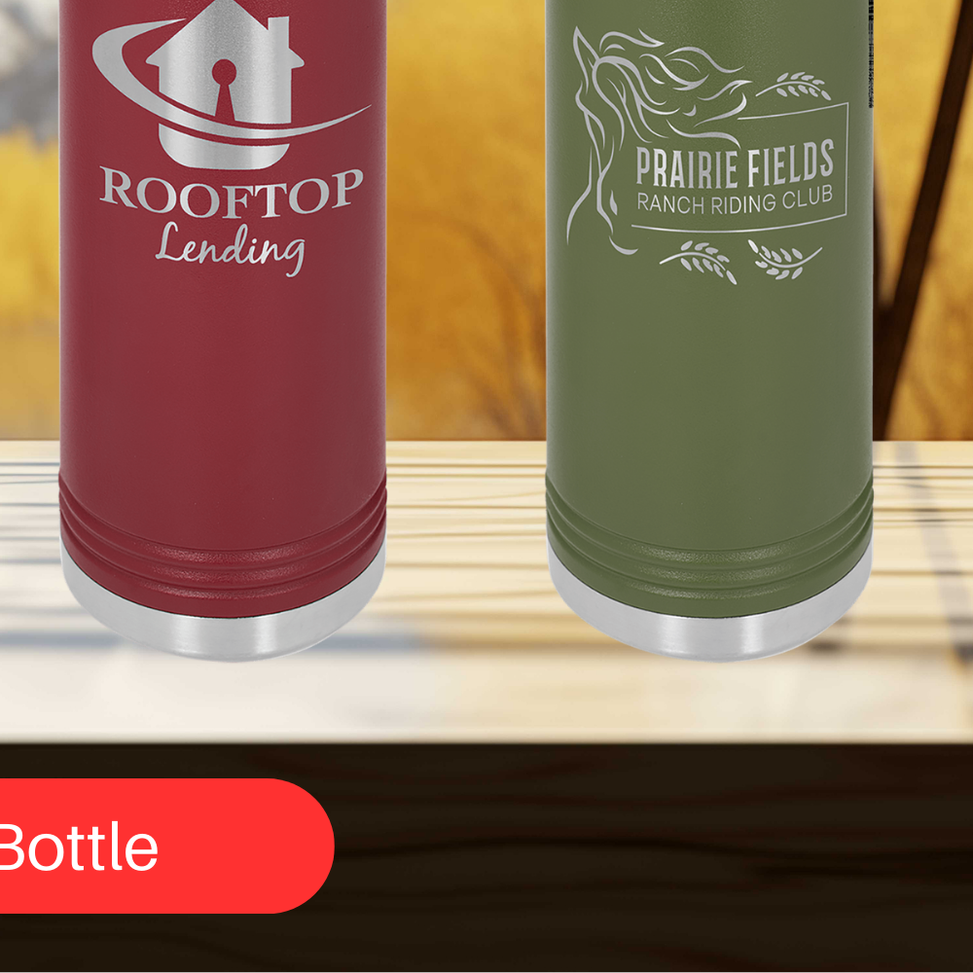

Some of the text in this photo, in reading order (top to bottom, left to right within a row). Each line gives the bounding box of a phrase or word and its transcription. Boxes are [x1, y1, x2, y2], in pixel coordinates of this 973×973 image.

[636, 138, 835, 190] PRAIRIE FIELDS
[99, 165, 365, 219] ROOFTOP
[637, 184, 833, 215] RANCH RIDING CLUB
[154, 221, 306, 278] Lending
